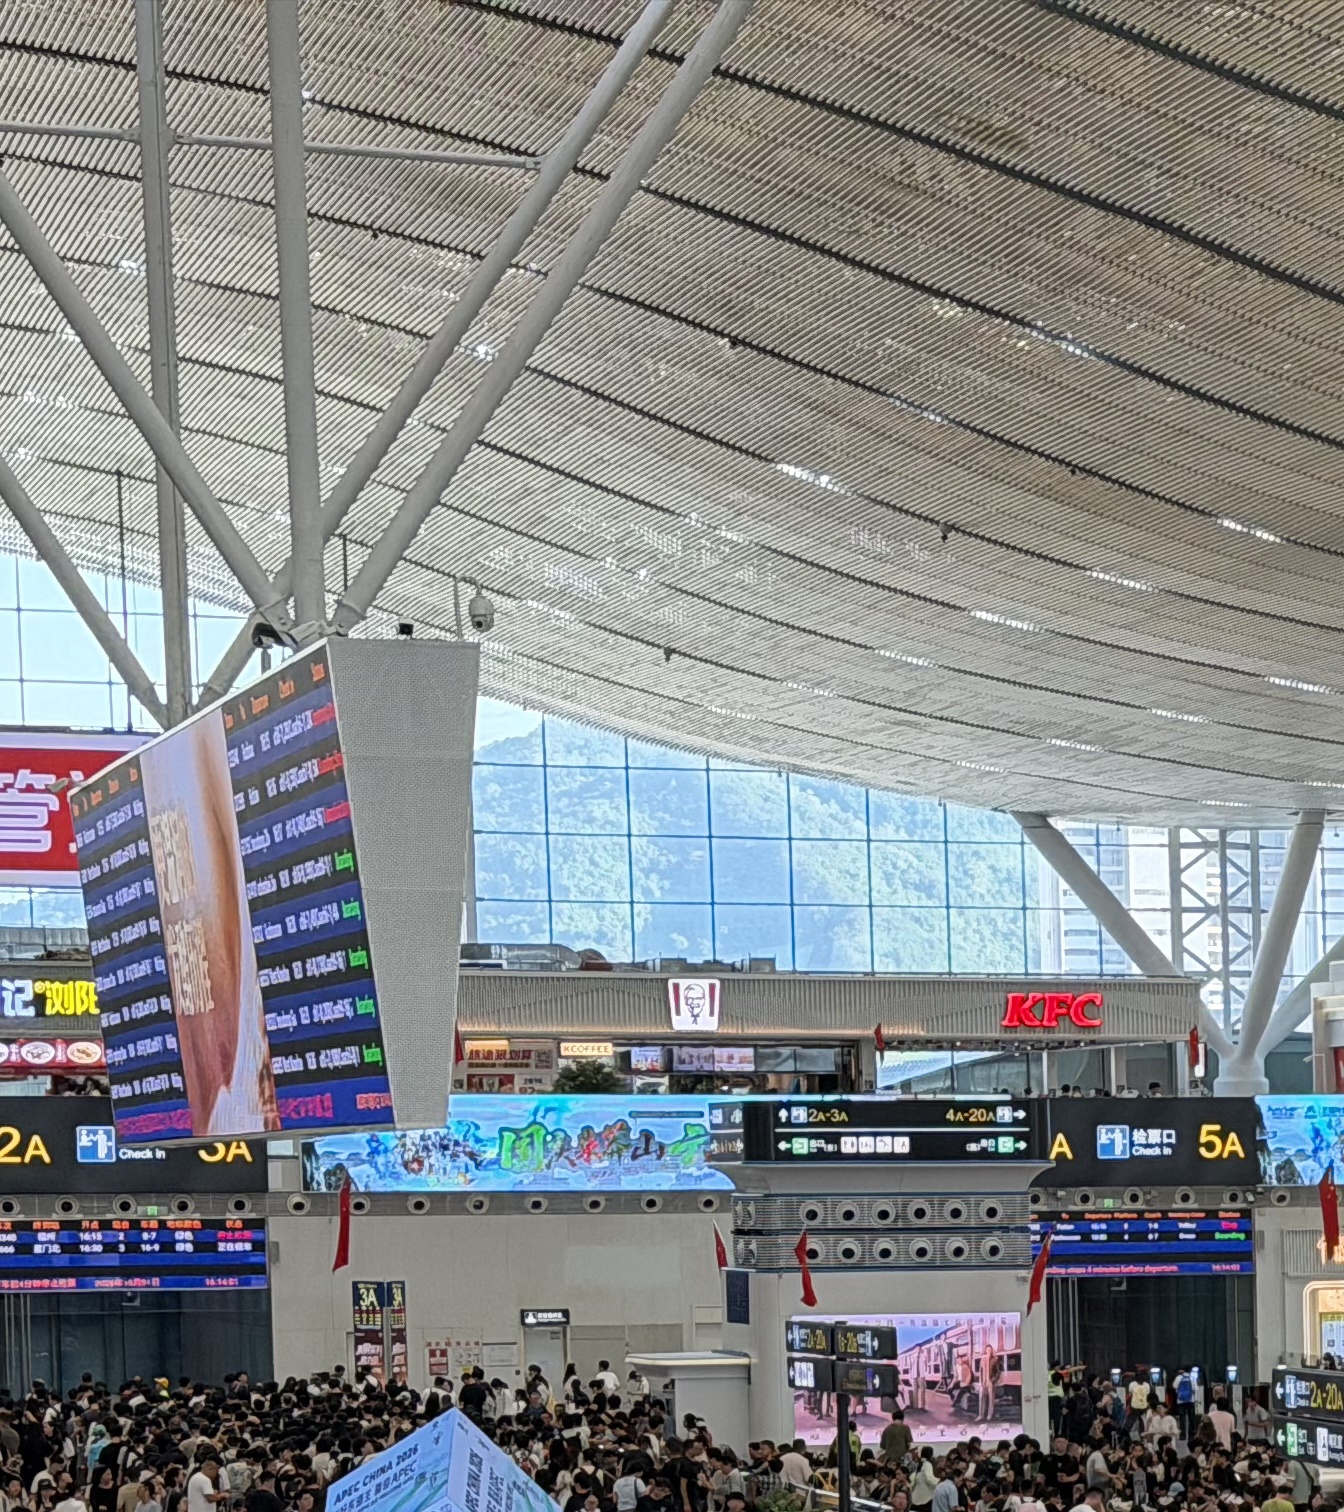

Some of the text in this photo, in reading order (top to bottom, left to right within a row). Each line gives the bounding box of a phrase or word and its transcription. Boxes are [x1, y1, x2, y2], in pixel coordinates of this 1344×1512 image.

[1001, 992, 1103, 1028] KFC
[808, 1108, 995, 1122] 2A-3A 4A-20A
[119, 1147, 152, 1160] Check
[1132, 1128, 1176, 1145] 检票口
[1199, 1124, 1246, 1159] 5A
[359, 1288, 379, 1308] 3A
[1310, 1379, 1344, 1411] 2A-20A
[334, 1480, 361, 1506] APEC
[362, 1460, 393, 1487] CHINA
